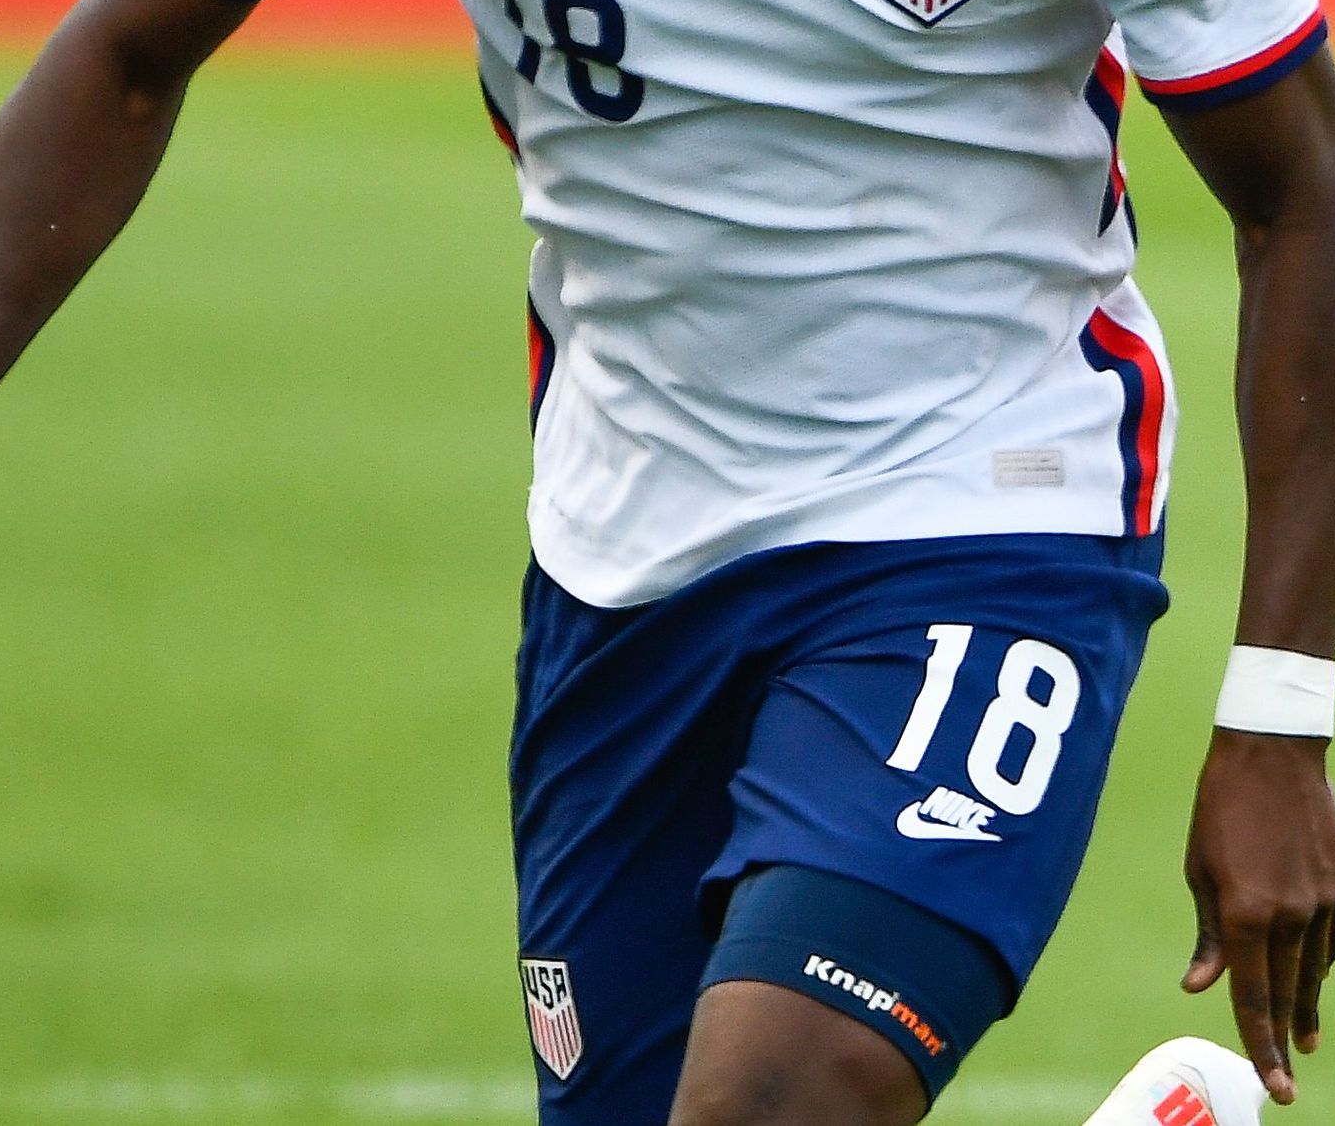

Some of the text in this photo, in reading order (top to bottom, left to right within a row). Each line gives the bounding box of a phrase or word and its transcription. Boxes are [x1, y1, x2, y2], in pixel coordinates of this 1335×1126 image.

[886, 624, 1081, 815] 18
[918, 786, 997, 830] NIKE
[524, 966, 567, 1010] USA
